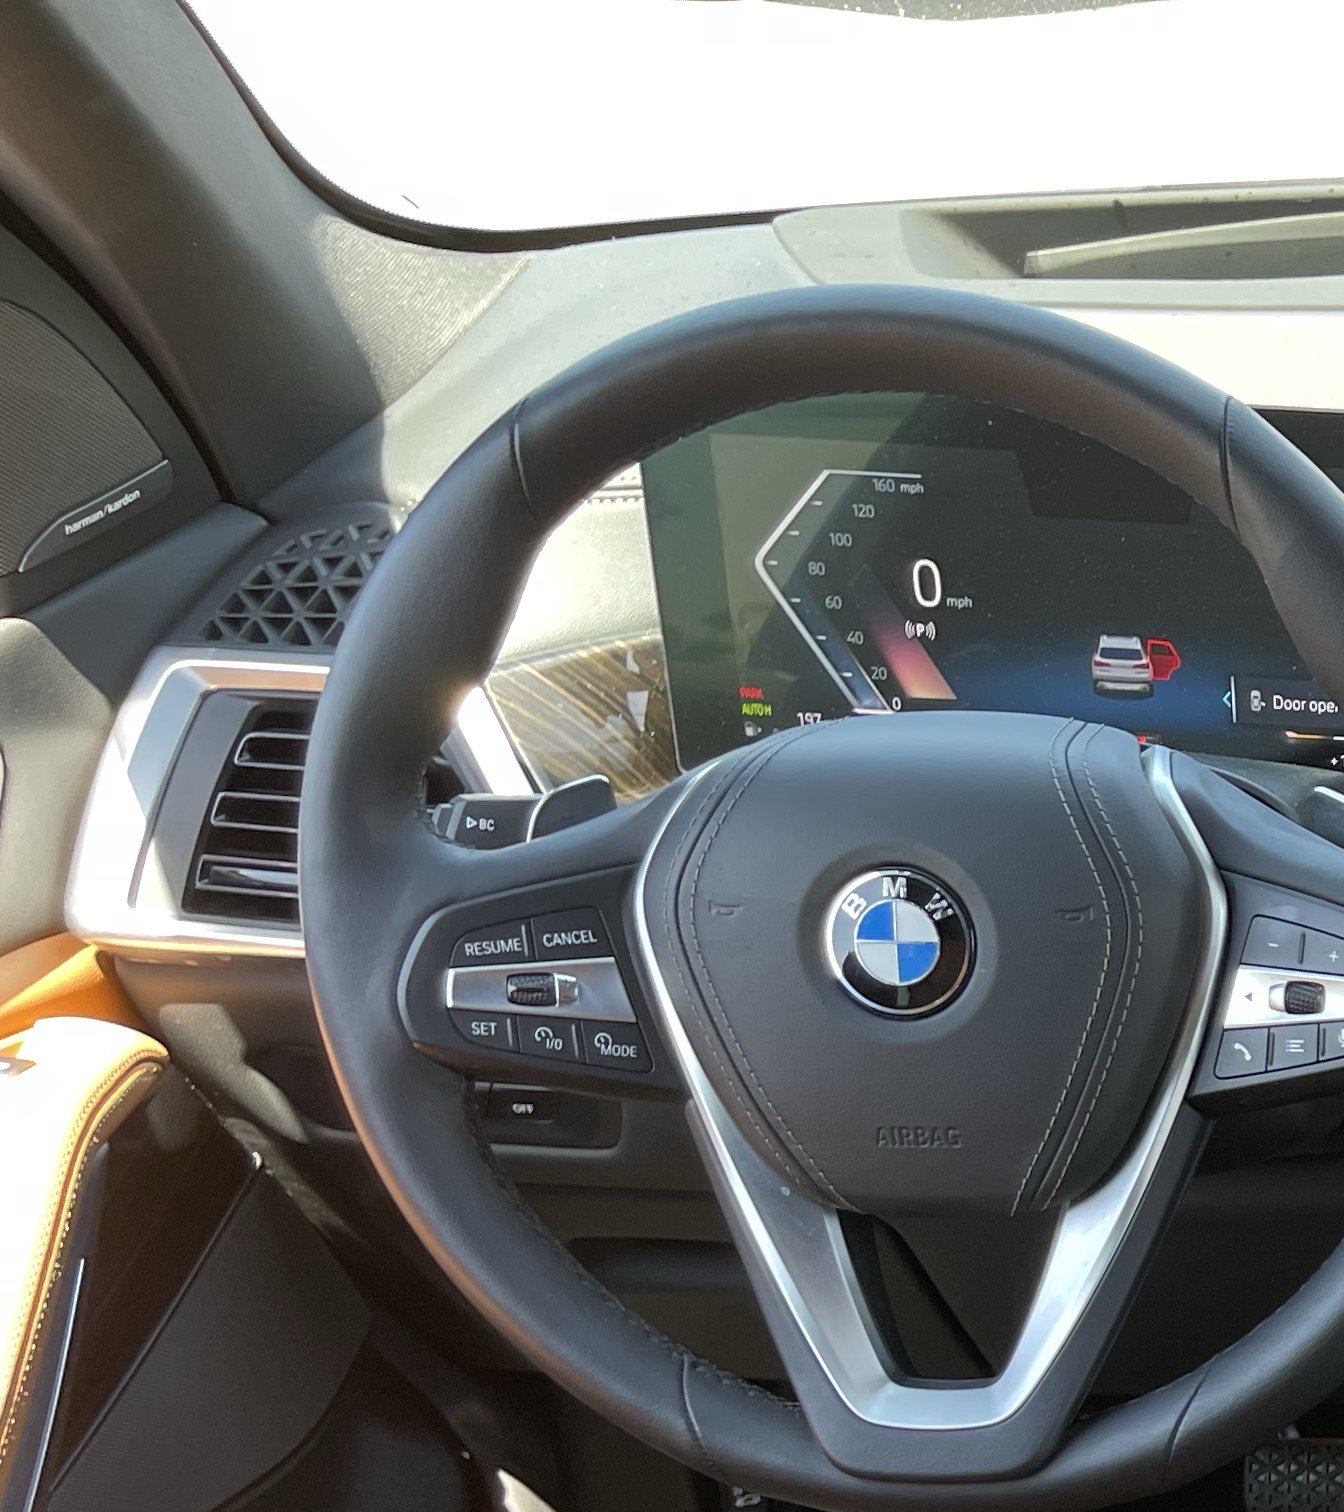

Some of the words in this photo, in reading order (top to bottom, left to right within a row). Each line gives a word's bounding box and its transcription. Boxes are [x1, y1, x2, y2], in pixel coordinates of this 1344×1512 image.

[872, 479, 895, 493] 160
[900, 482, 924, 494] mph
[852, 504, 875, 518] 120
[829, 532, 852, 547] 100
[808, 562, 825, 576] 80
[912, 558, 942, 608] 0
[825, 596, 842, 610] 60
[947, 597, 973, 610] mph
[846, 631, 864, 645] 40
[871, 667, 888, 681] 20
[742, 703, 764, 716] AUTO
[892, 697, 902, 711] 0
[1272, 694, 1307, 712] Door
[1308, 702, 1339, 715] ope
[841, 876, 953, 921] BMW
[543, 929, 598, 948] CANCEL
[464, 937, 523, 957] RESUME
[471, 1022, 498, 1037] SET
[600, 1043, 638, 1058] MODE
[876, 1126, 963, 1149] AIRBAG
